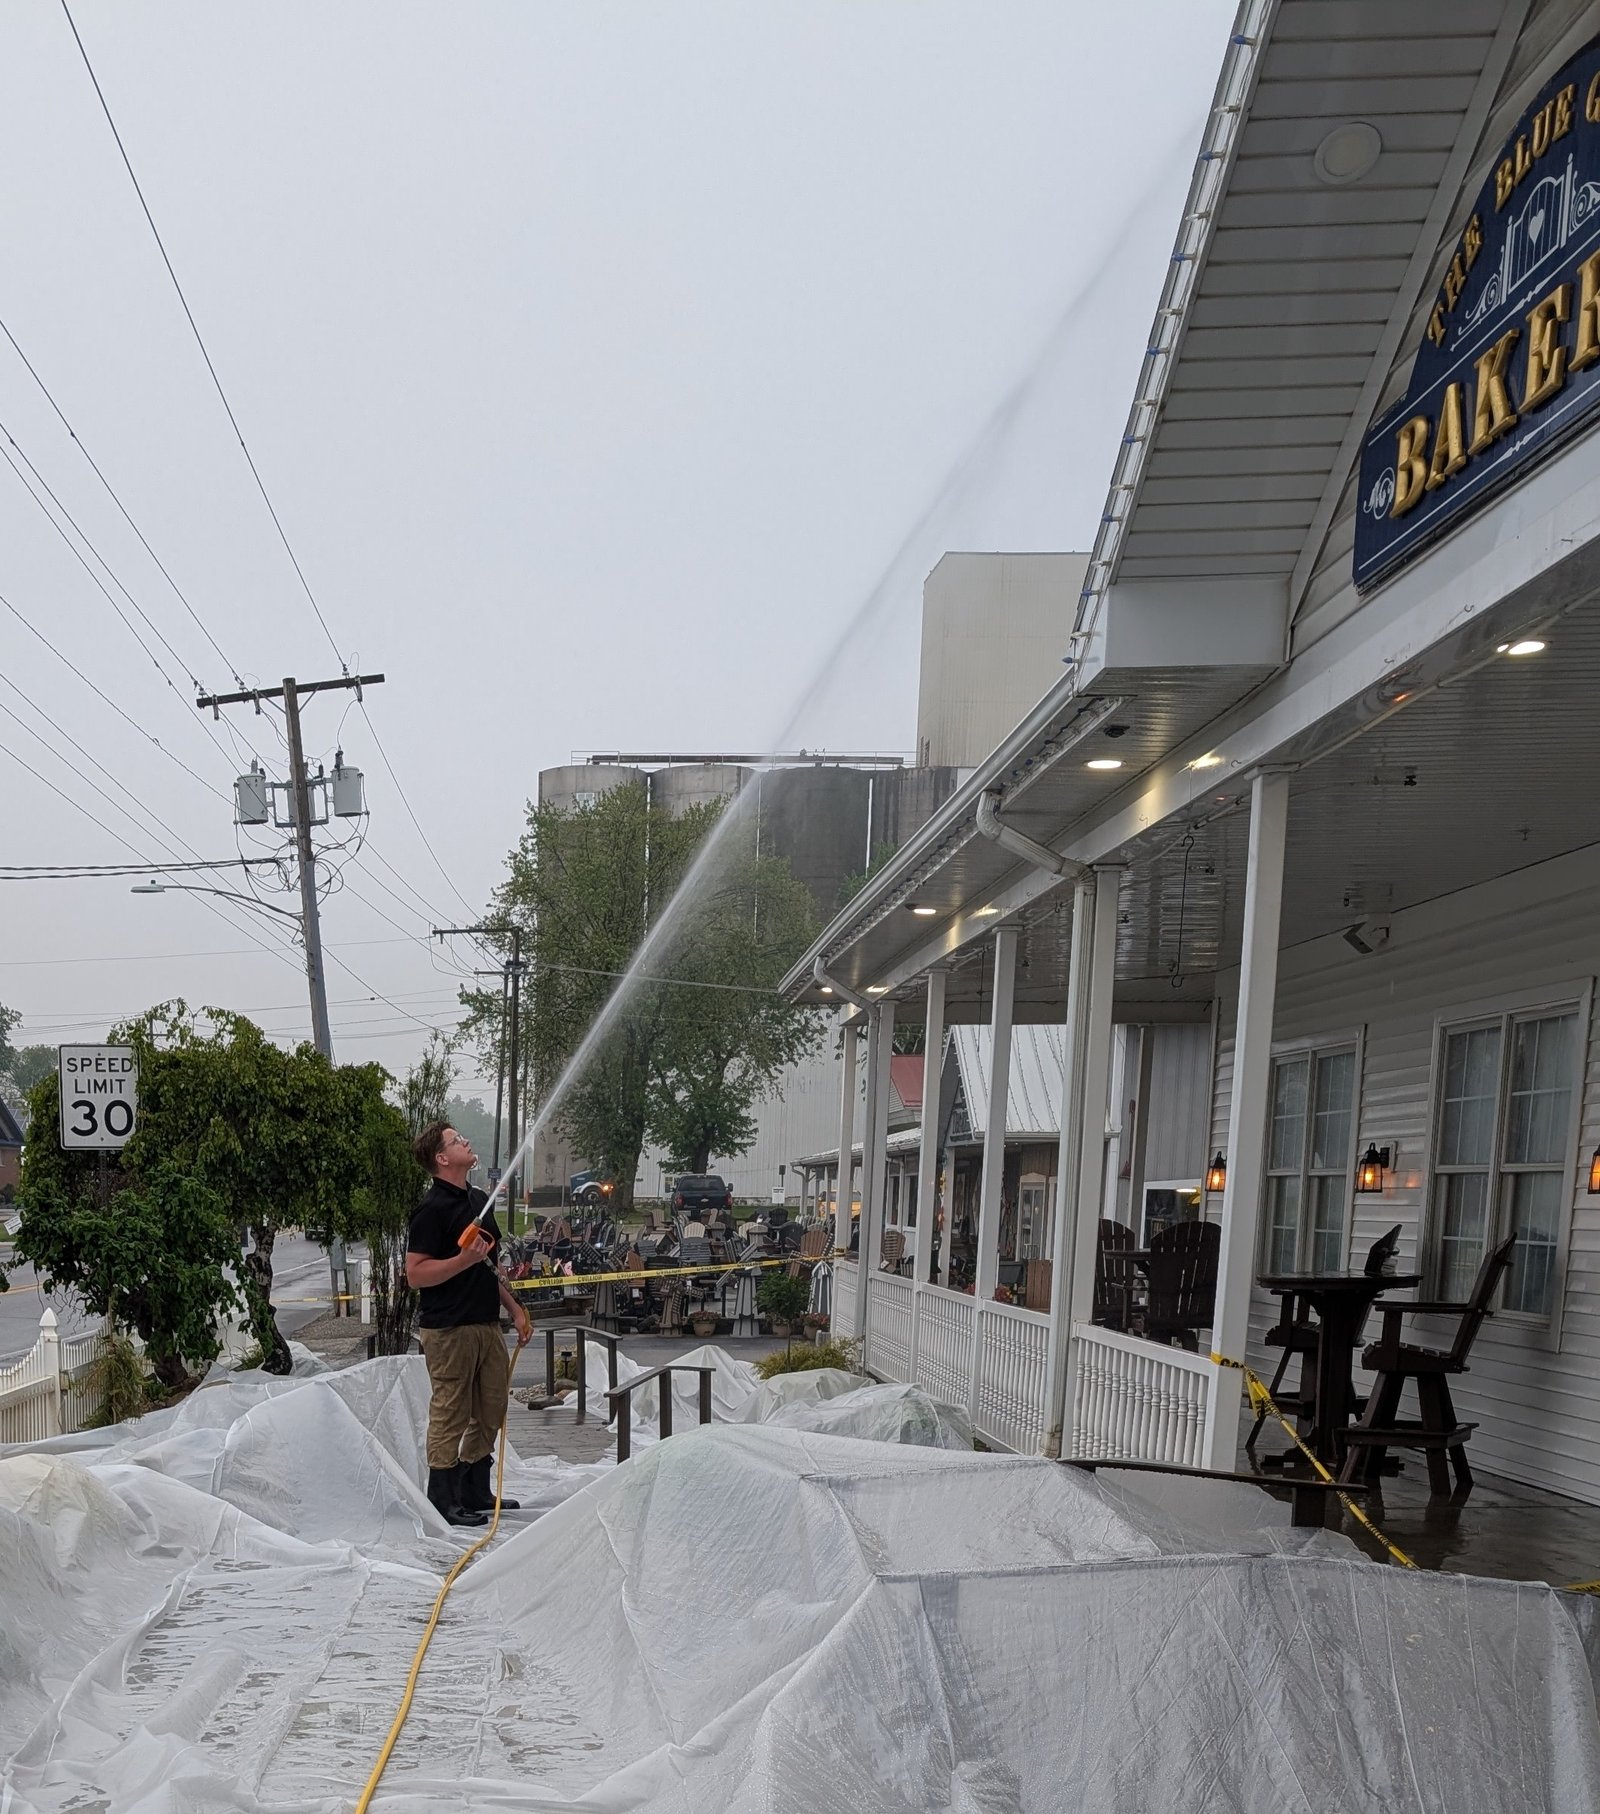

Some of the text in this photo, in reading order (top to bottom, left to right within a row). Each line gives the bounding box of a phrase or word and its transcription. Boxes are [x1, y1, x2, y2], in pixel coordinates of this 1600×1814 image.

[1427, 213, 1483, 348] THE
[1495, 83, 1575, 214] BLUE
[66, 1057, 133, 1073] SPEED
[74, 1078, 126, 1094] LIMIT
[70, 1099, 134, 1137] 30
